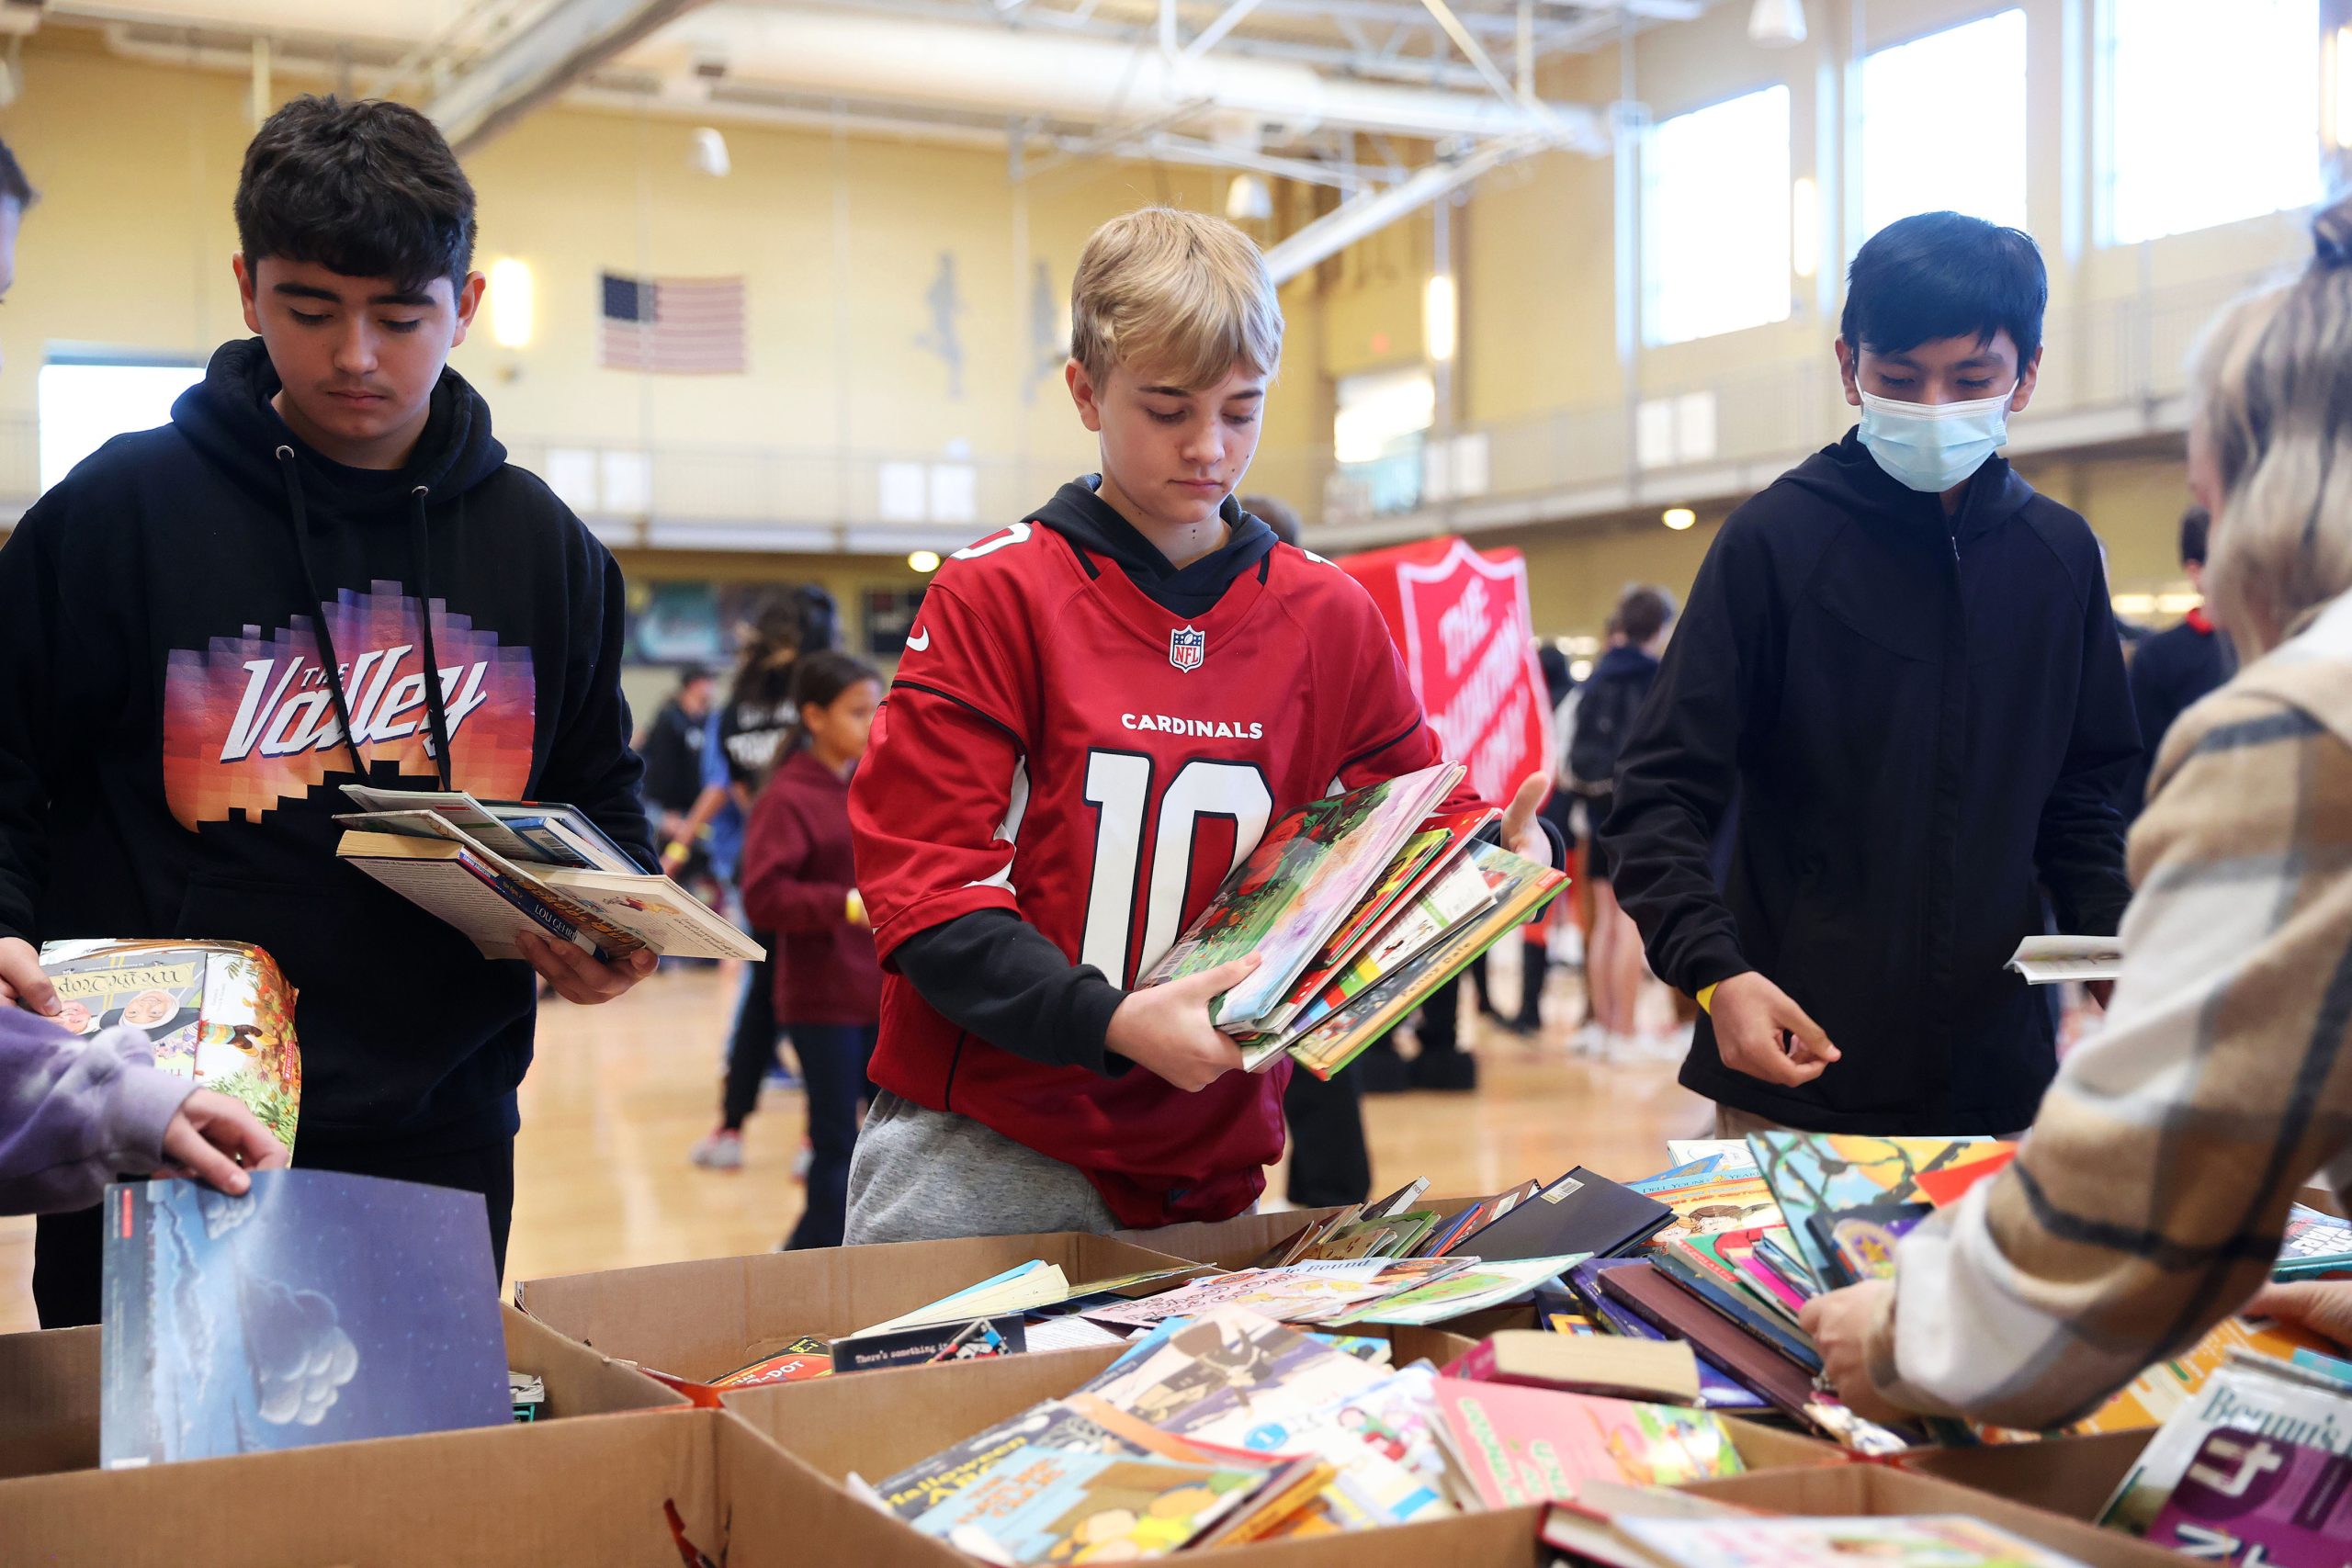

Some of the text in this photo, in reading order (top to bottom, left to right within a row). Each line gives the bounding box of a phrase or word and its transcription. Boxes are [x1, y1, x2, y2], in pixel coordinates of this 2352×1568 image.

[1174, 646, 1200, 665] NFL
[300, 662, 350, 687] THE
[220, 644, 488, 763] Valley
[1121, 712, 1263, 740] CARDINALS
[1078, 746, 1275, 991] 10
[534, 903, 552, 924] LOU
[1400, 941, 1472, 998] Penny Dale
[285, 1042, 294, 1076] SCHOLASTIC
[1306, 1258, 1370, 1274] Bound
[1679, 1238, 1737, 1282] SCHOLASTIC
[1103, 1296, 1165, 1312] The
[855, 1349, 888, 1364] There's
[890, 1344, 936, 1359] something
